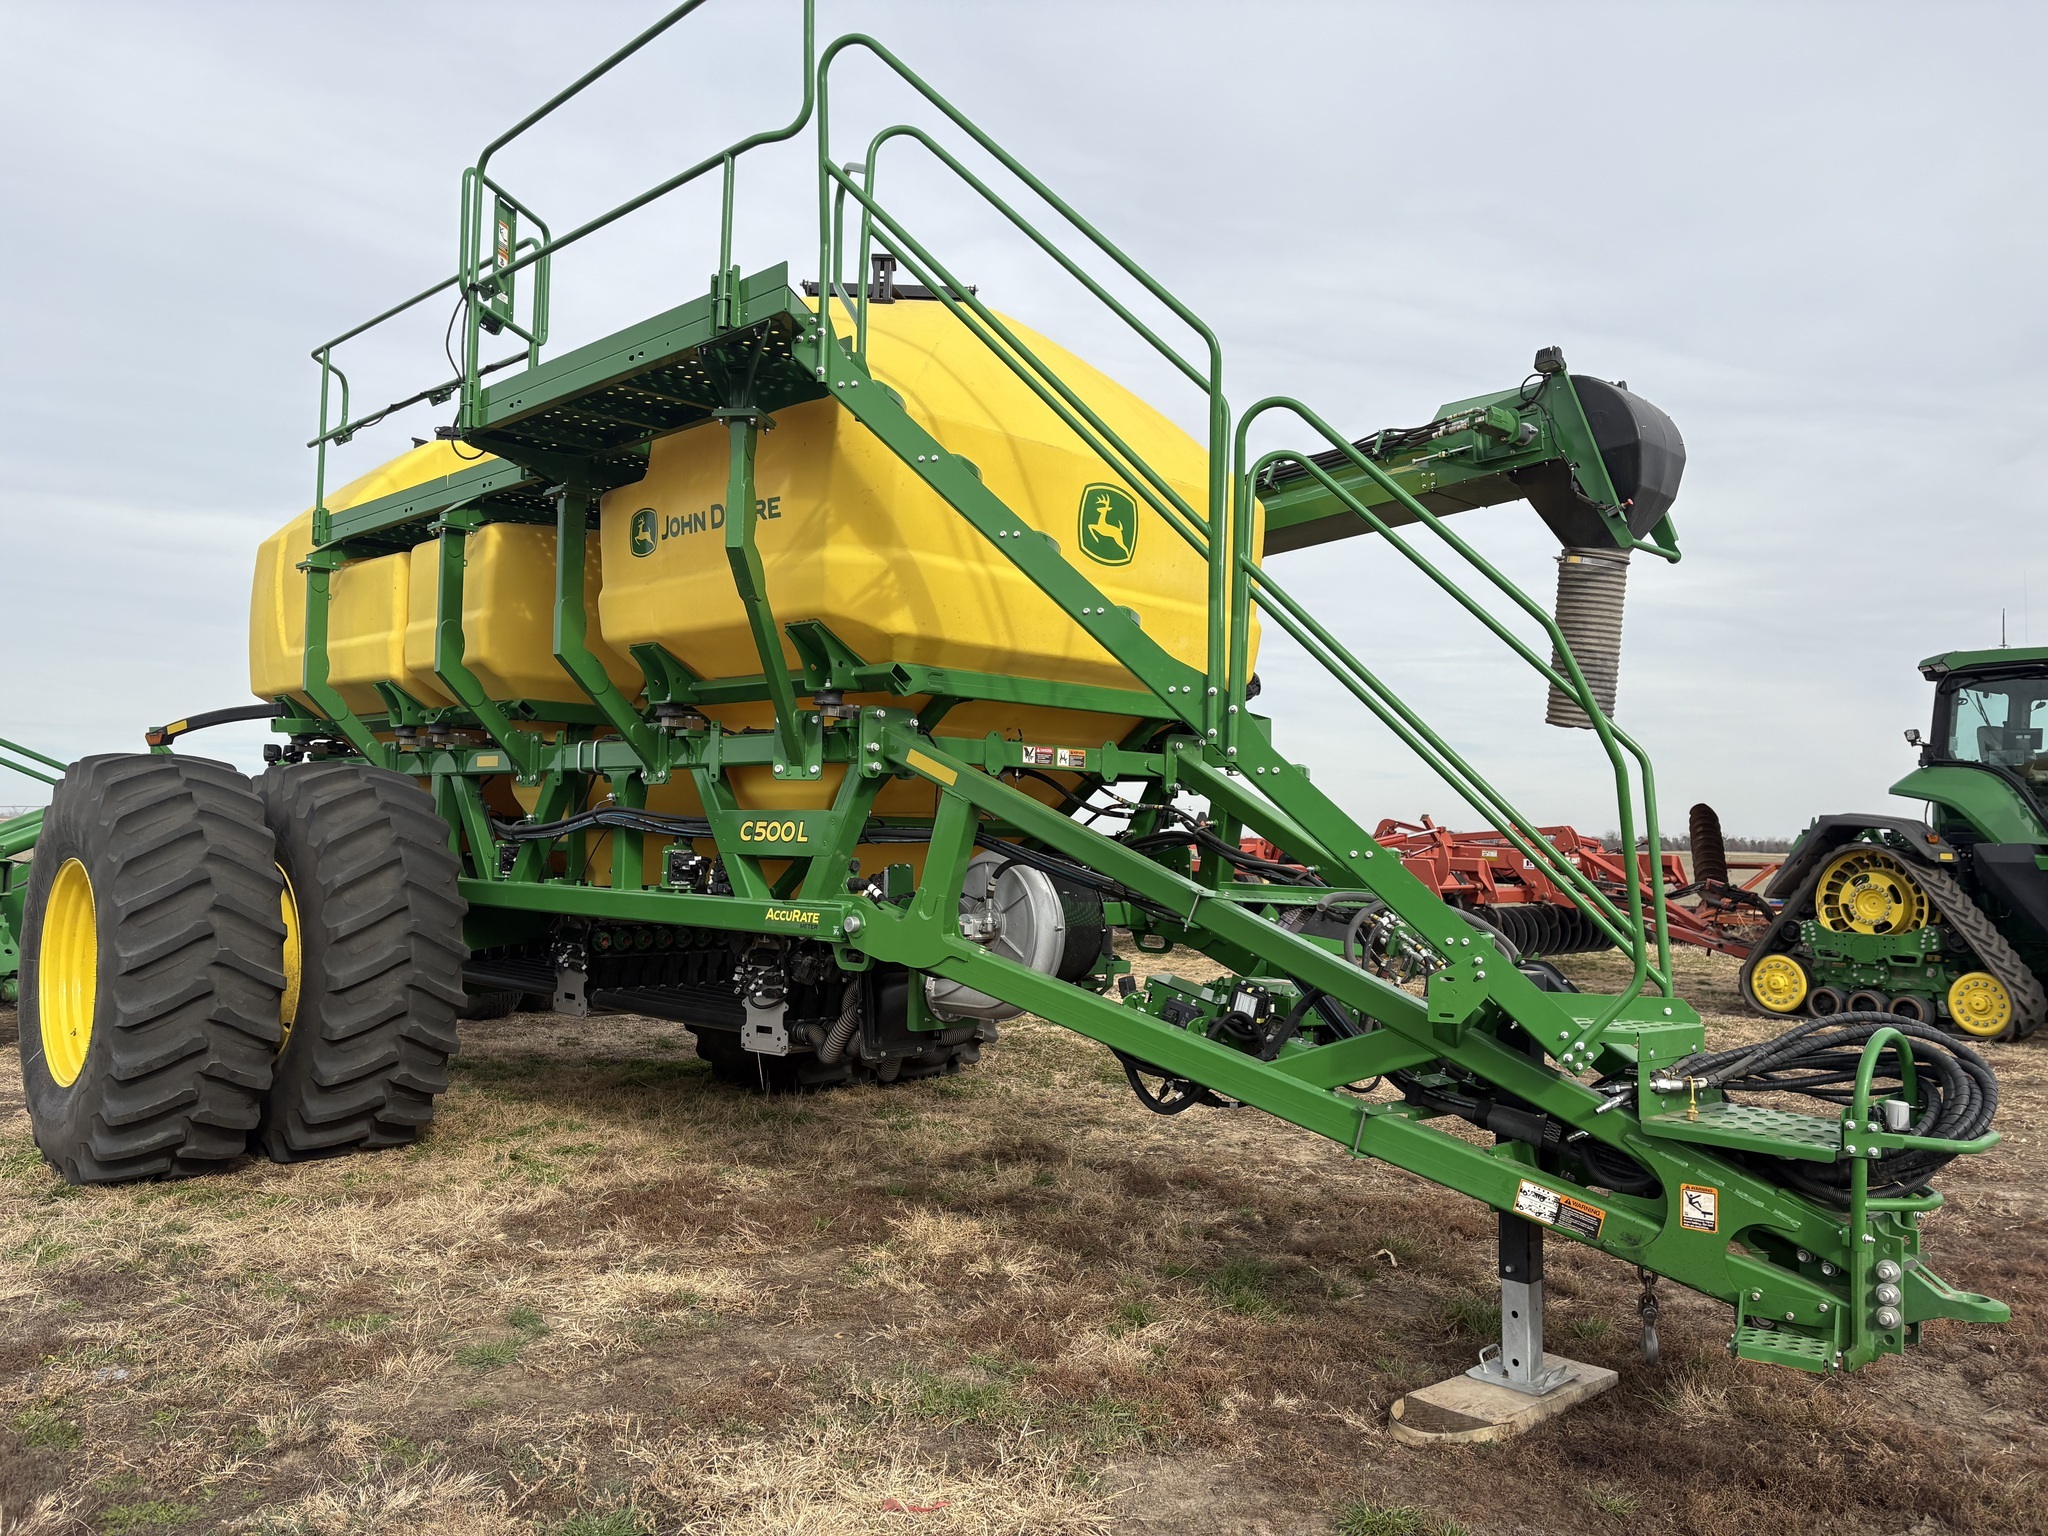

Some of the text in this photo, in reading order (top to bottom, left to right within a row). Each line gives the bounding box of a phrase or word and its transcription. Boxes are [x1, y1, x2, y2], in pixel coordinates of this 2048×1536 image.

[661, 497, 781, 540] JOHN DRE
[740, 820, 809, 843] C500L
[1572, 1200, 1601, 1217] WARNING
